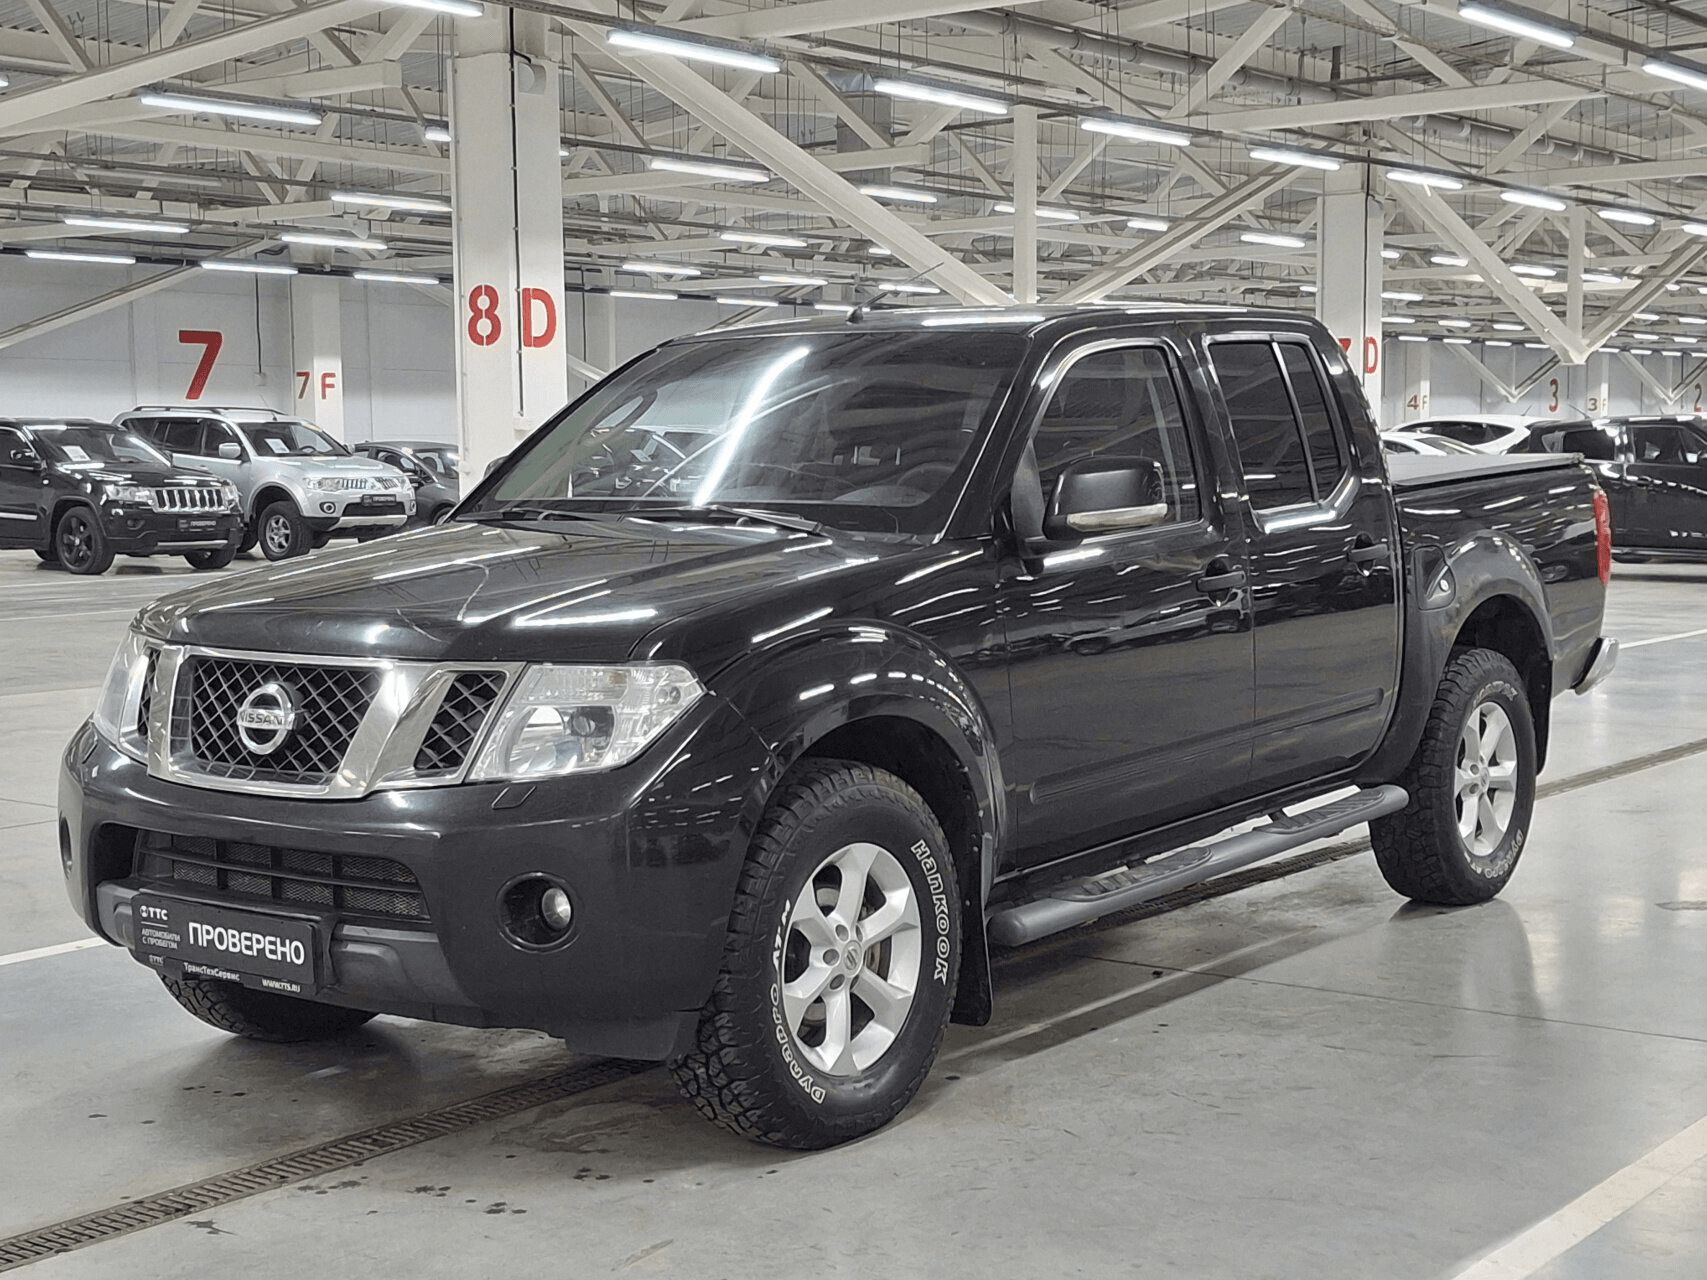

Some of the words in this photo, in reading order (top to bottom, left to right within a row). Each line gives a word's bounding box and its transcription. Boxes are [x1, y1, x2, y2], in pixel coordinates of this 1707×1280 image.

[468, 284, 501, 346] 8
[521, 287, 557, 348] D
[178, 330, 223, 400] 7
[1364, 336, 1378, 374] D
[296, 372, 310, 399] 7
[321, 373, 336, 399] F
[1549, 378, 1559, 412] 3
[1694, 383, 1702, 412] 2
[1407, 395, 1419, 410] 4
[1588, 398, 1598, 411] 3
[240, 711, 283, 726] NISSAN
[188, 921, 305, 965] ПРОВЕРЕНО
[183, 962, 240, 981] ТрансТехСервис
